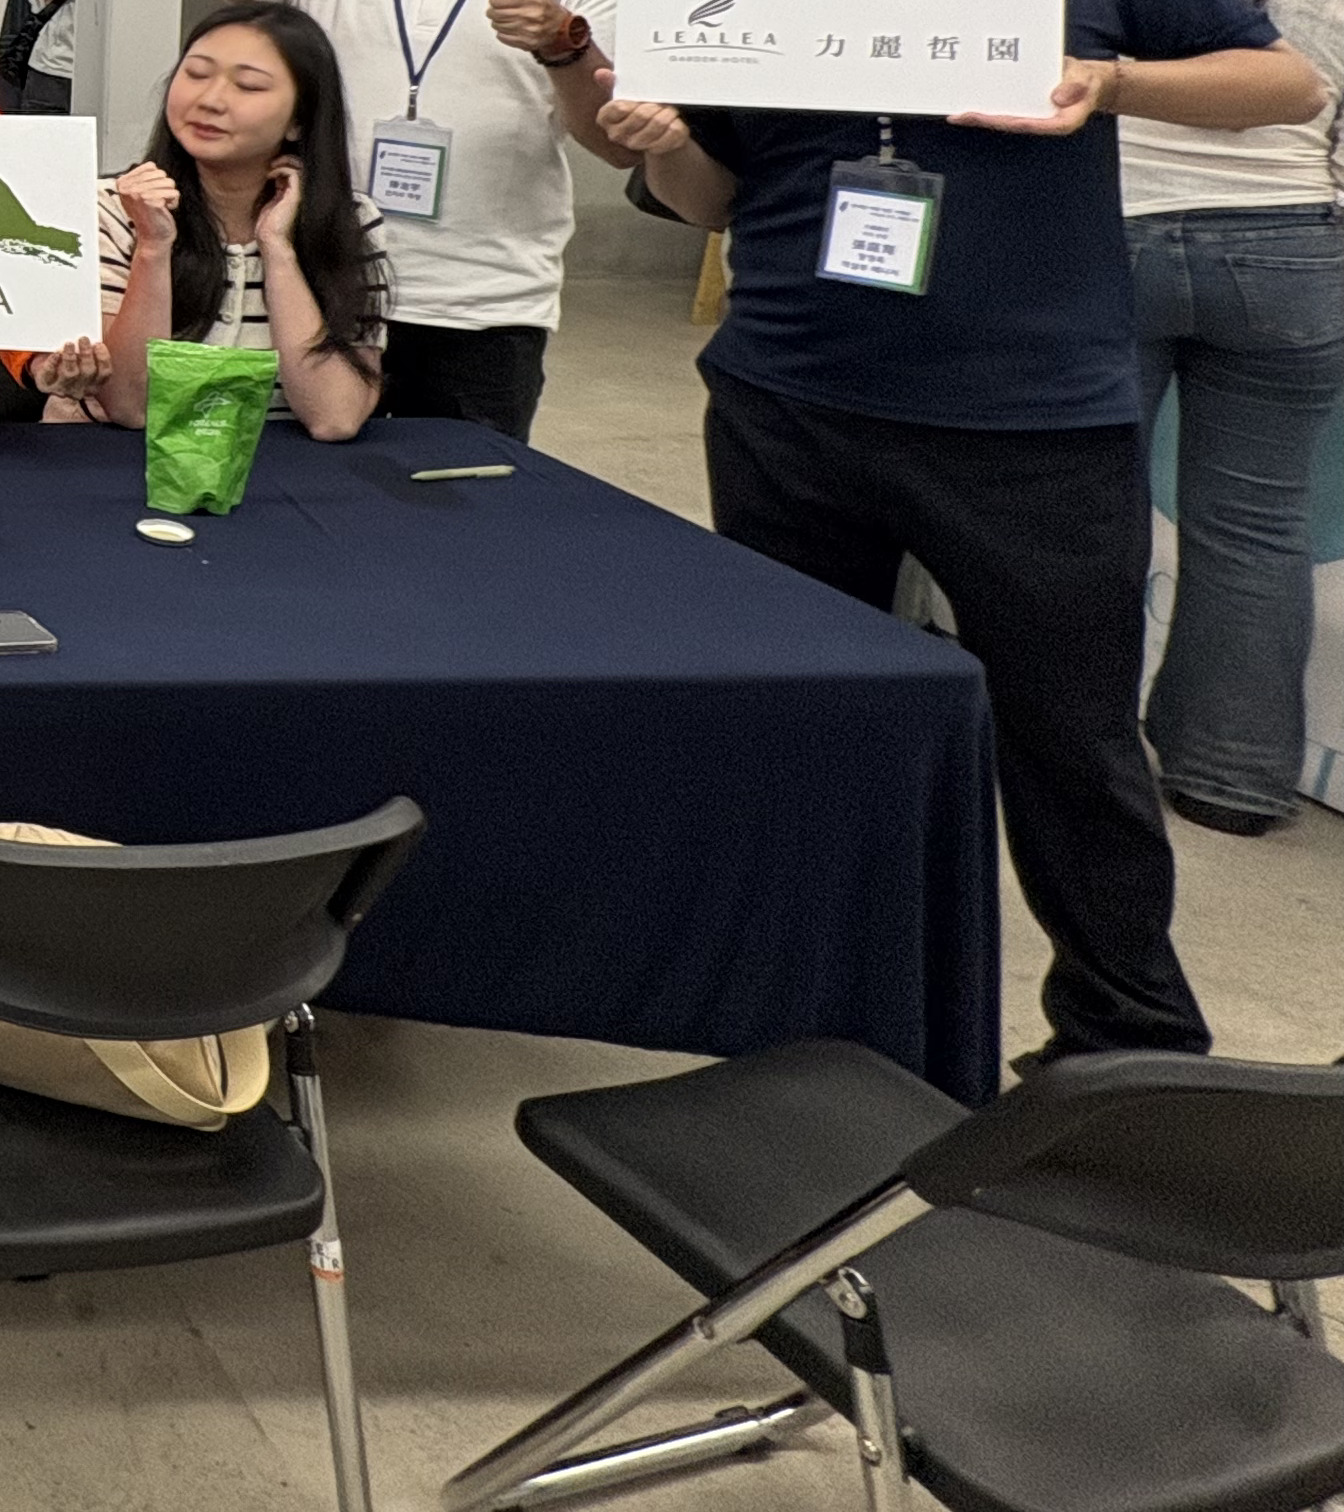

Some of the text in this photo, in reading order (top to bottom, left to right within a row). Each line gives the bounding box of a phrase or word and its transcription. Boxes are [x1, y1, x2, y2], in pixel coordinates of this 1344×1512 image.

[652, 31, 777, 45] LEALEA
[815, 34, 1020, 62] 力麗哲園
